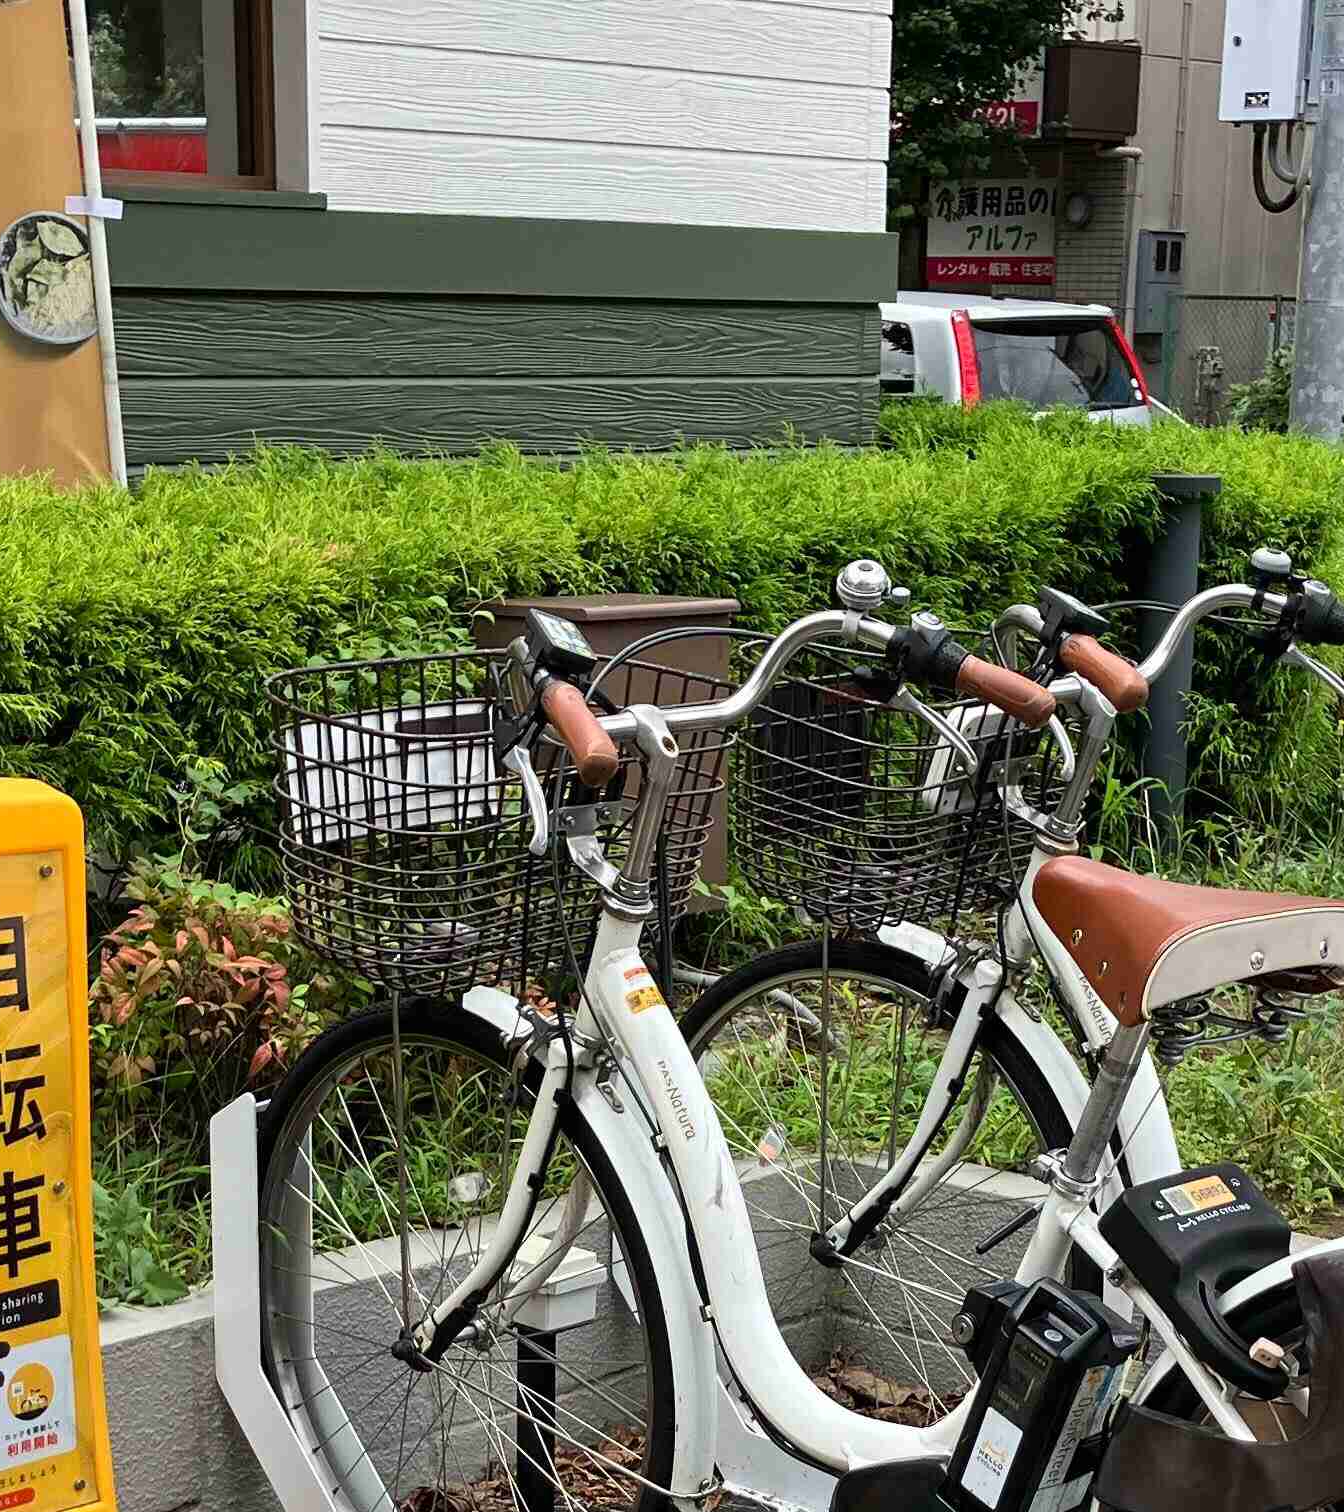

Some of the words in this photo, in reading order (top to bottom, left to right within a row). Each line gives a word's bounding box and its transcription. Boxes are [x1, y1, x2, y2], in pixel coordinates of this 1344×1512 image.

[936, 186, 1056, 223] 介護用品の
[966, 224, 1038, 252] アルファ
[667, 1086, 696, 1139] Natura
[2, 1290, 44, 1311] sharing
[7, 1431, 59, 1457] 利用開始
[978, 1447, 1004, 1471] HELLO
